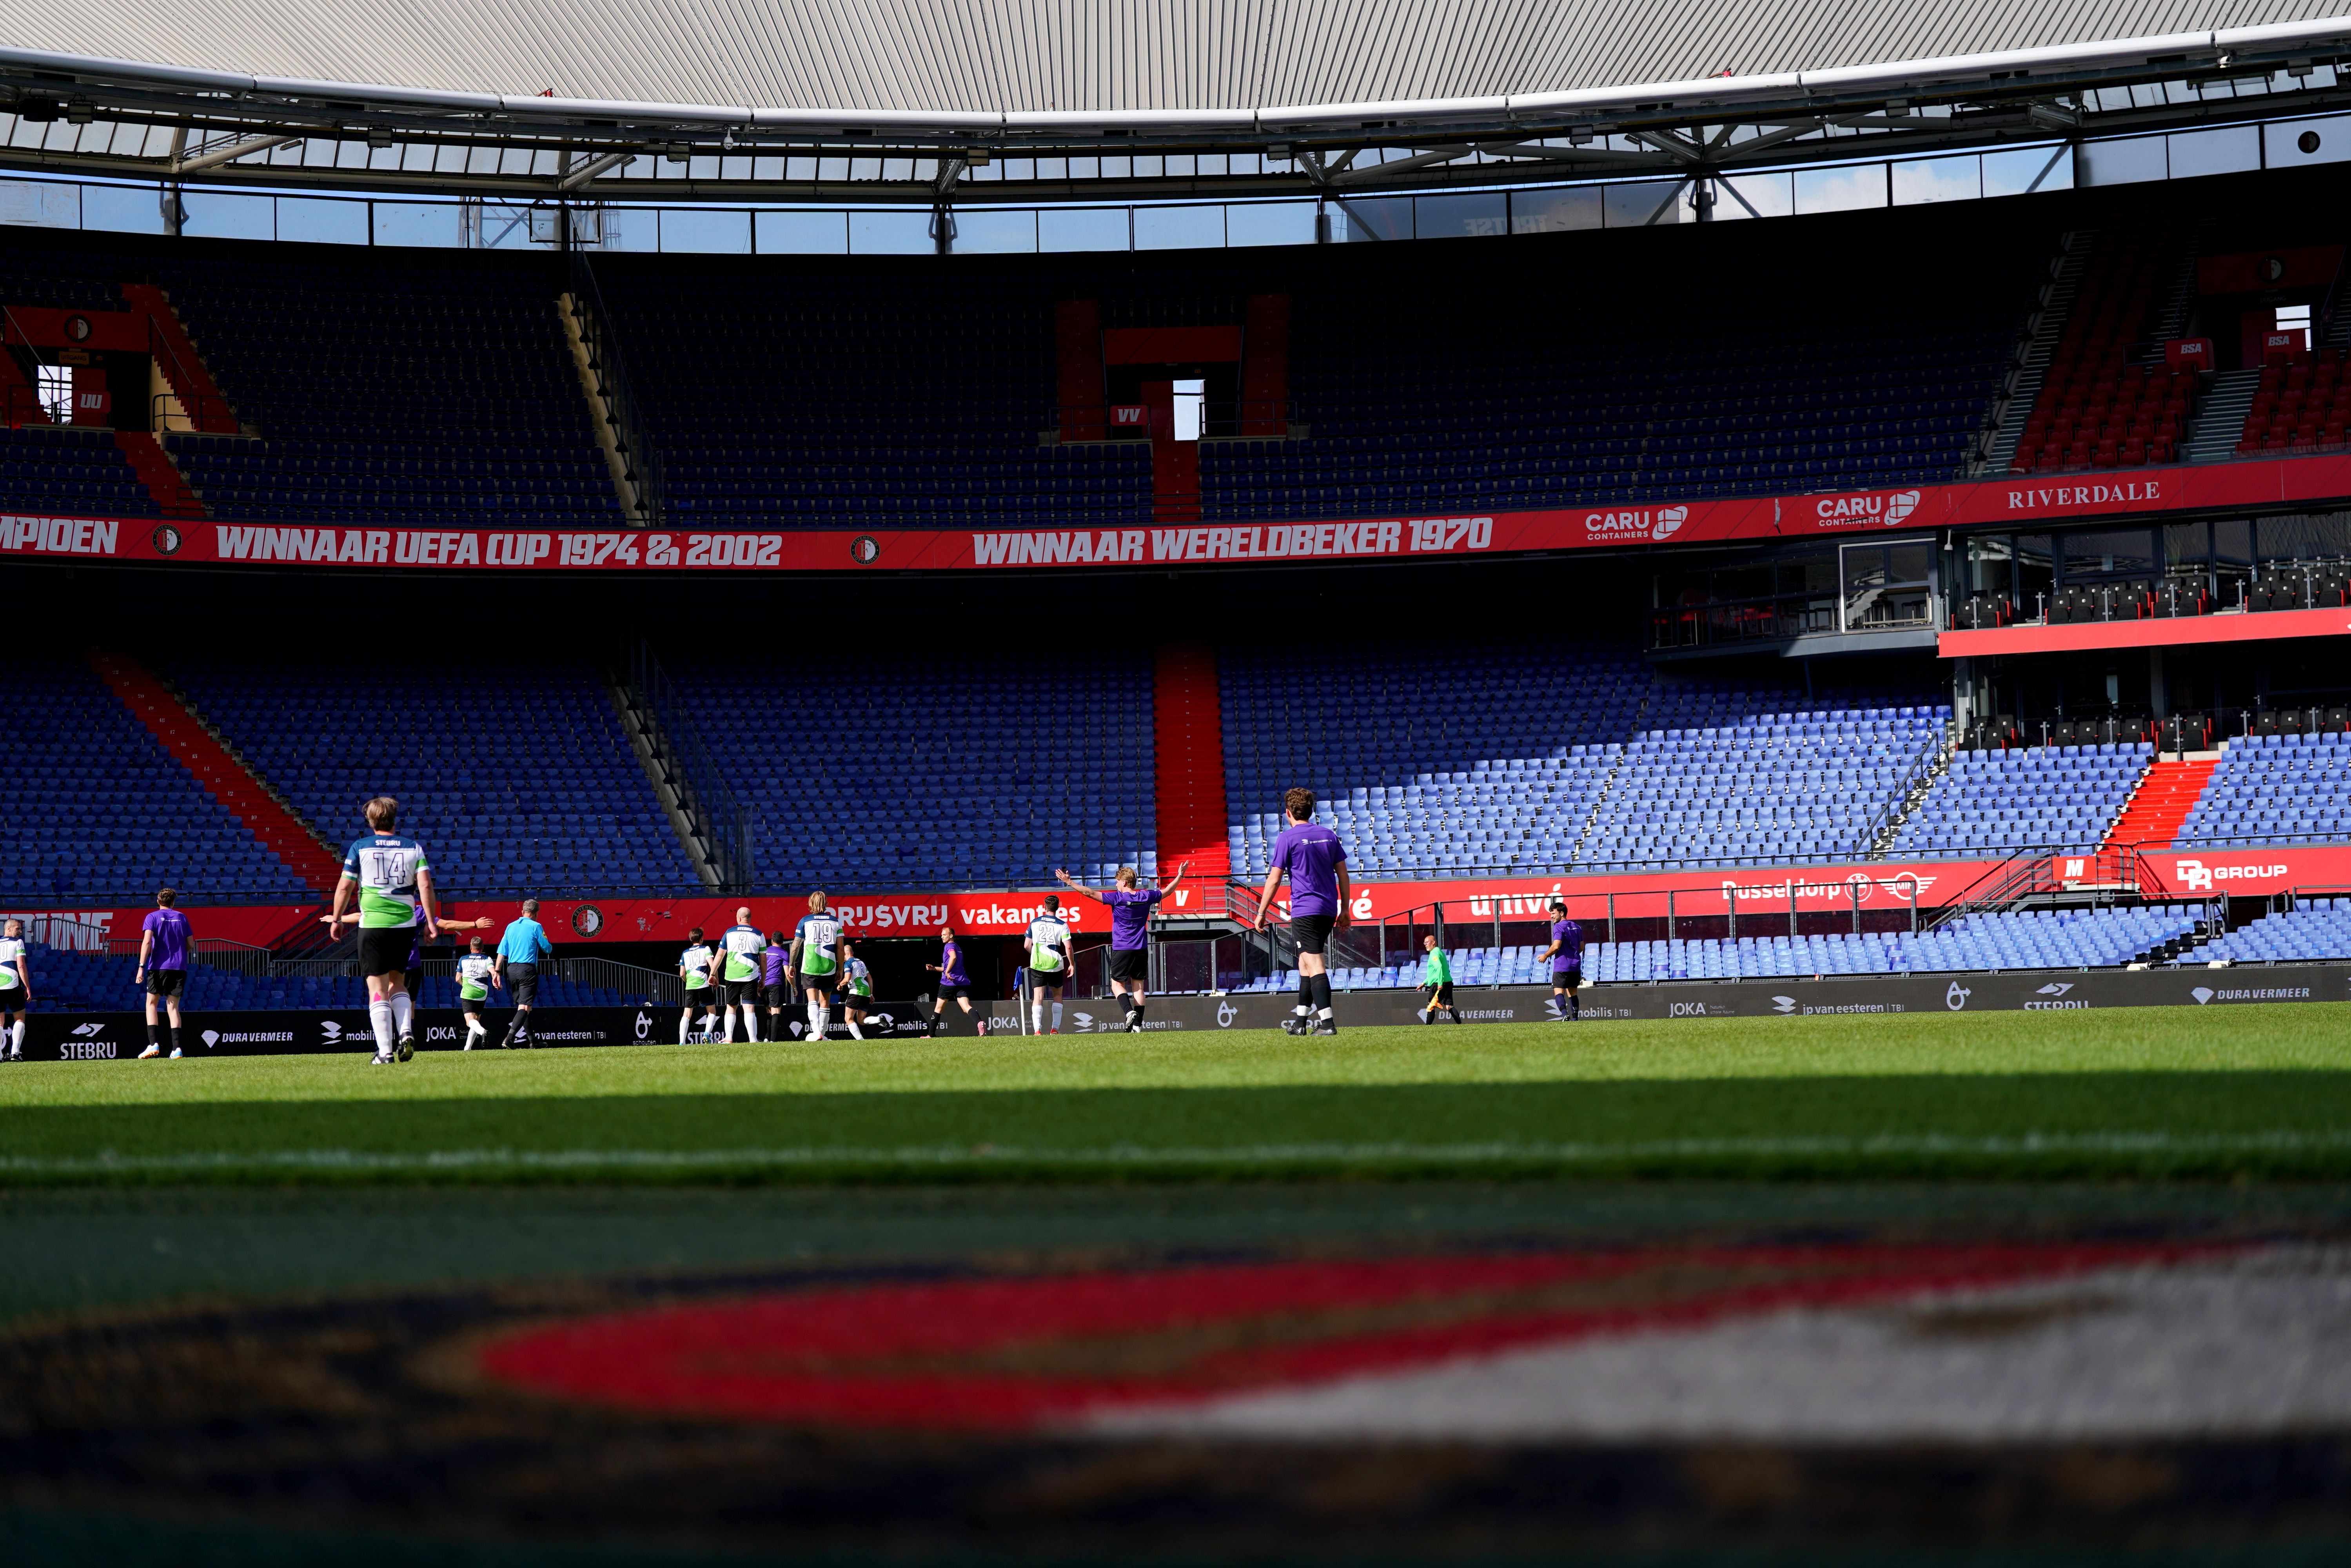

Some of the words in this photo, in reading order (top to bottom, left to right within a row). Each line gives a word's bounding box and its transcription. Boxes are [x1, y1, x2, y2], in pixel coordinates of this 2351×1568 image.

[2181, 343, 2202, 354] BSA
[2268, 335, 2290, 347] BSA
[80, 393, 102, 408] UU
[1117, 408, 1141, 422] VV
[2008, 481, 2160, 509] RIVERDALE
[1817, 496, 1881, 517] CARU
[1585, 511, 1649, 531] CARU
[853, 536, 878, 546] FEYENOORD
[972, 530, 1146, 564] WINNAAR
[1151, 522, 1400, 560] WERELDBEKER
[1409, 517, 1493, 551] 1970
[1587, 531, 1648, 541] CONTAINERS
[216, 526, 390, 563] WINNAAR
[395, 532, 479, 564] UEFA
[486, 534, 551, 565] CUP
[558, 534, 639, 565] 1974
[646, 534, 680, 566] &
[686, 535, 782, 566] 2002
[373, 853, 405, 884] 14
[2064, 859, 2084, 877] M
[2214, 864, 2287, 879] GROUP
[1722, 878, 1841, 900] Dusseldorp
[1896, 882, 1911, 890] MIN
[1175, 890, 1189, 906] V
[574, 906, 601, 916] FEYENOORD
[960, 904, 1081, 925] vakantes
[813, 923, 832, 943] 19
[1039, 924, 1054, 943] 22
[738, 934, 748, 951] 3
[688, 951, 700, 968] 18
[470, 962, 478, 976] 2
[1439, 1011, 1465, 1019] DUA
[1669, 1002, 1706, 1018] JOKA
[1803, 1004, 1813, 1016] jp
[1836, 1004, 1884, 1013] eesteren
[897, 1020, 928, 1030] mobilis
[987, 1017, 1018, 1031] JOKA
[1098, 1020, 1107, 1032] jp
[1142, 1020, 1166, 1029] teren
[346, 1030, 375, 1040] mobili
[426, 1027, 456, 1042] JOKA
[541, 1032, 556, 1040] van
[557, 1031, 591, 1039] eesteren
[60, 1042, 117, 1059] STEBRU
